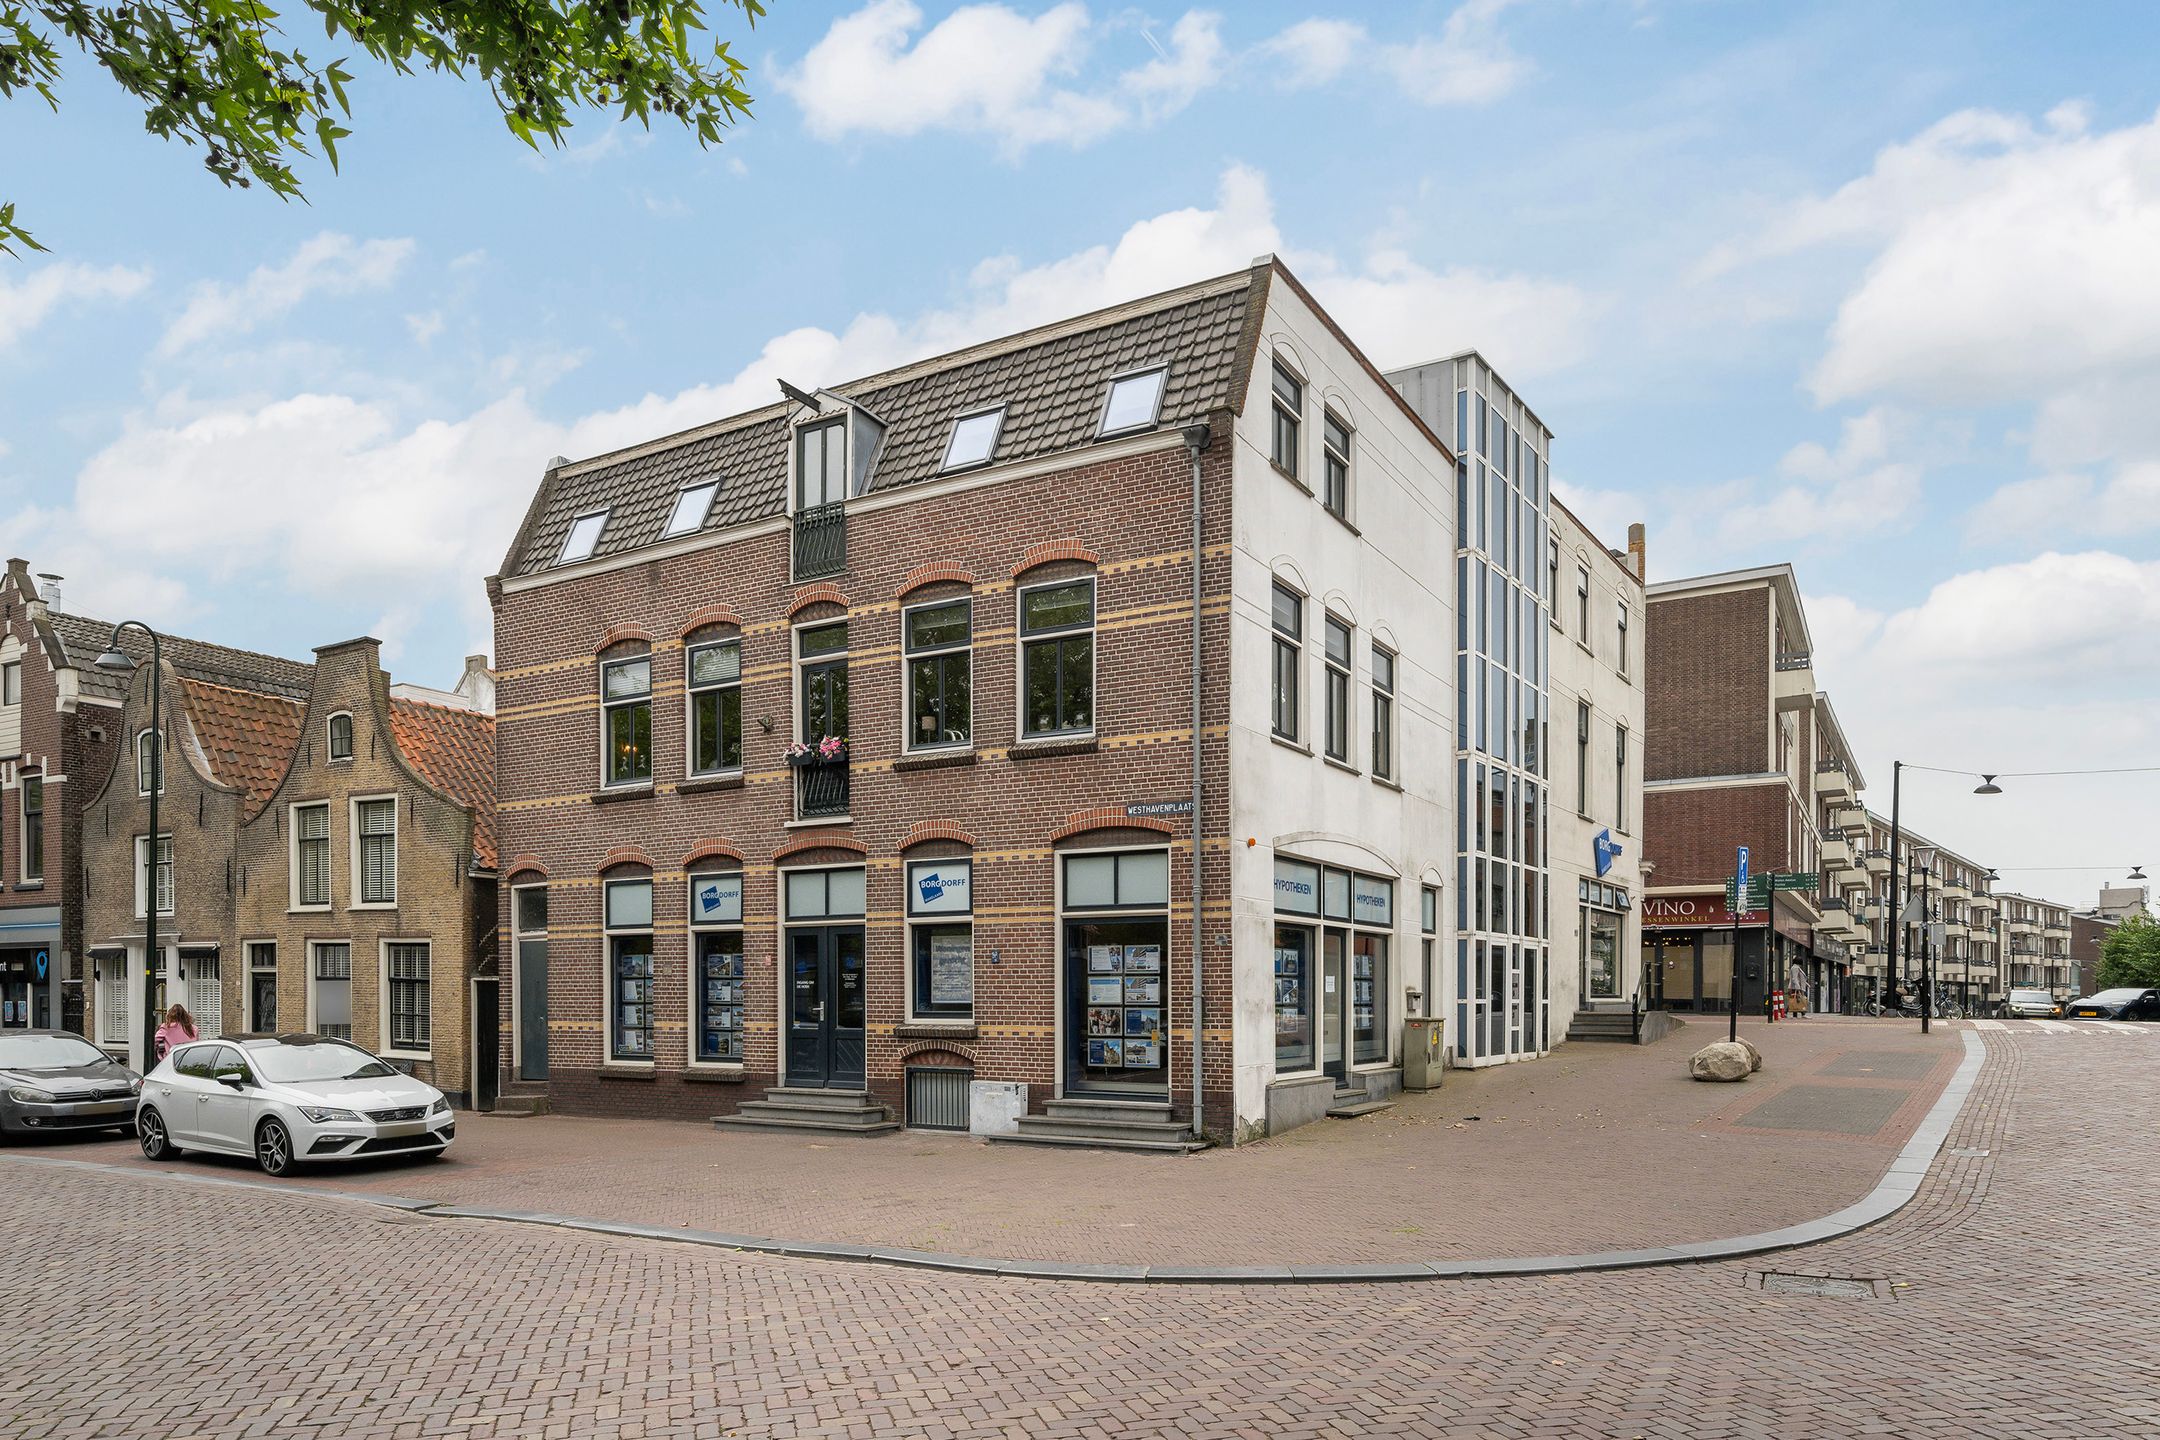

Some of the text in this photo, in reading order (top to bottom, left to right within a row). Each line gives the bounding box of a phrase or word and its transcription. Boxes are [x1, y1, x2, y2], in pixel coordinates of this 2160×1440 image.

[920, 879, 966, 889] BORGDORFF
[1274, 879, 1312, 895] HYPOTHEKEN
[702, 891, 740, 900] BORGDORFF
[1356, 894, 1386, 907] HYPOTHEKEN
[1642, 900, 1695, 915] VINO
